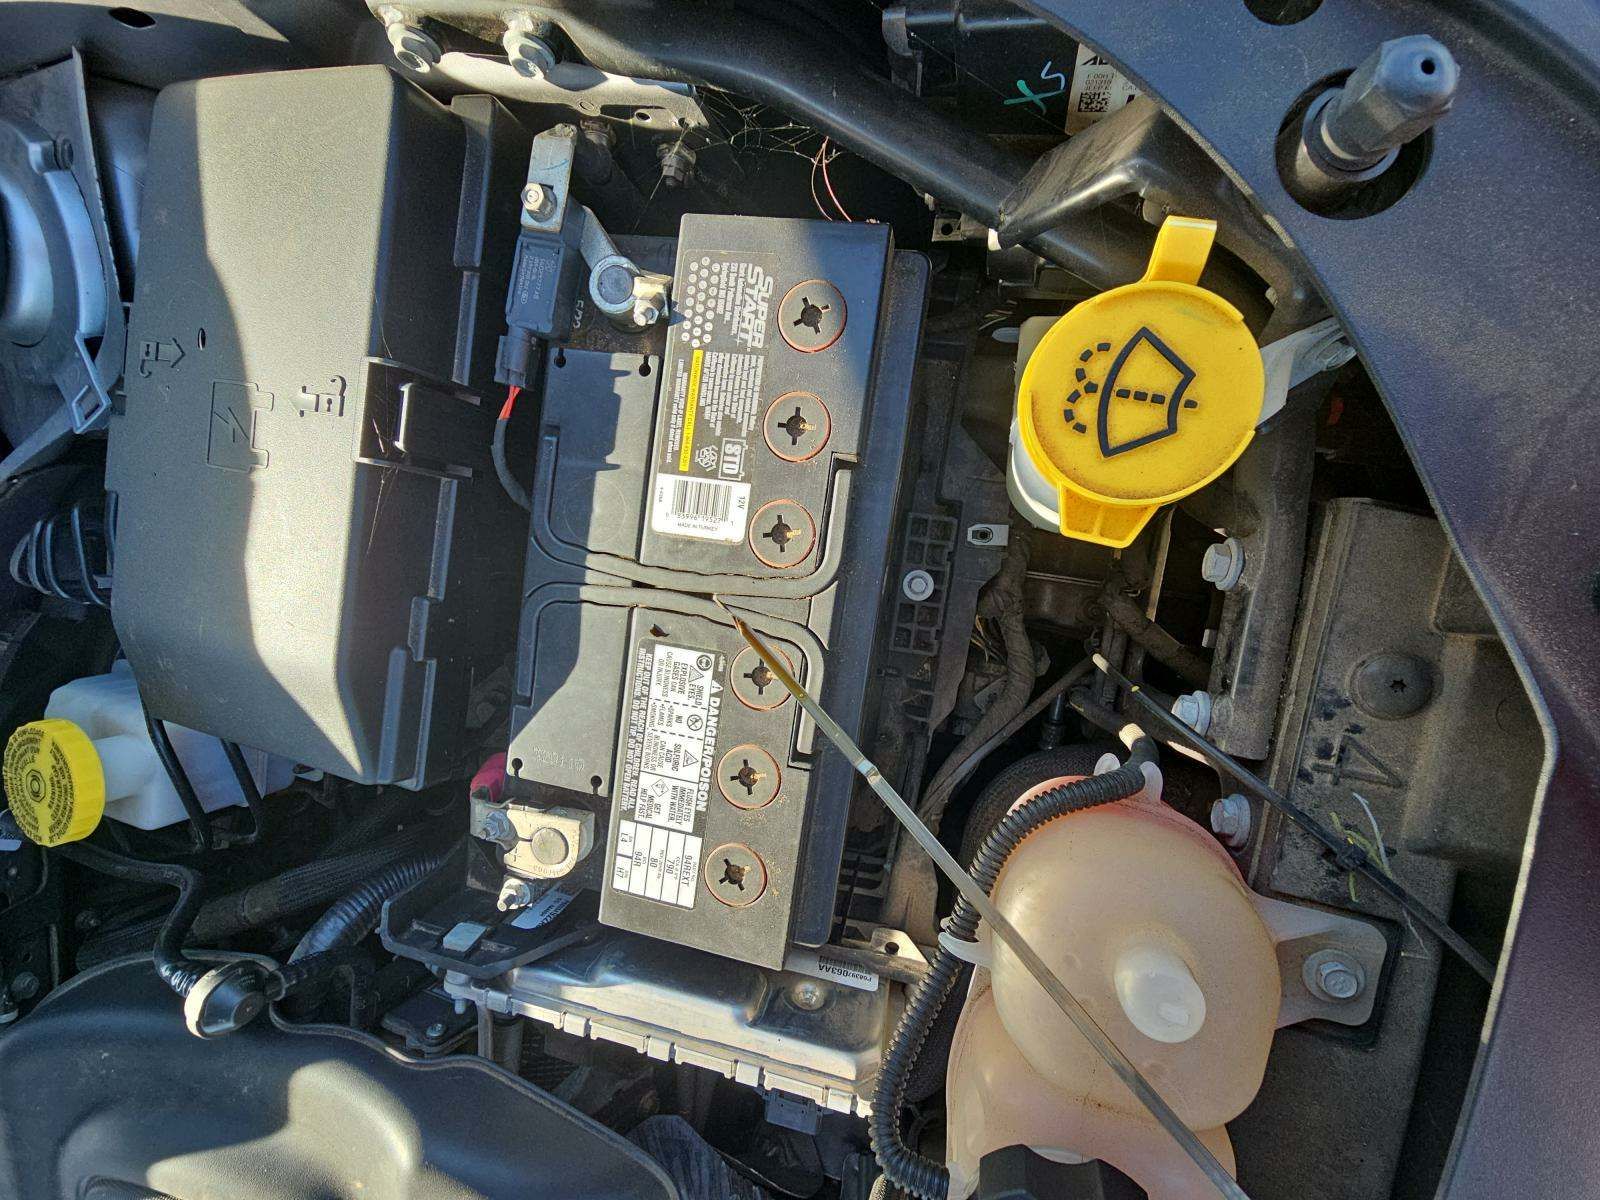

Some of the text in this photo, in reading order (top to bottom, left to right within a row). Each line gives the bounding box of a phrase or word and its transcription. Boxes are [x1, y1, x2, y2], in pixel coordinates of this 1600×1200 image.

[737, 263, 765, 347] START
[751, 275, 774, 348] SUPER
[722, 443, 741, 475] STD
[736, 496, 745, 509] 12V
[644, 653, 652, 670] KEEP
[642, 671, 650, 685] OUT
[671, 661, 680, 680] GASES
[677, 662, 688, 694] EXPLOSIVE
[641, 685, 648, 696] OF
[694, 684, 704, 705] SHIELD
[632, 699, 639, 709] DO
[639, 696, 647, 709] THE
[636, 710, 646, 732] REACH
[674, 714, 682, 723] NO
[628, 738, 635, 749] DO
[635, 733, 643, 742] OF
[664, 748, 672, 762] ACID
[671, 743, 681, 771] SULFURIC
[695, 696, 720, 811] DANGER/POISON
[623, 763, 631, 781] OPEN
[629, 779, 637, 796] READ
[639, 788, 647, 802] HELP
[670, 785, 678, 801] WITH
[627, 797, 635, 809] ALL
[653, 803, 661, 814] GET
[675, 786, 685, 824] IMMEDIATELY
[683, 788, 693, 821] FLUSH EYES
[620, 832, 628, 842] L4
[633, 851, 642, 866] 94R
[649, 857, 658, 867] 80
[665, 858, 674, 874] 790
[615, 866, 624, 878] H7
[681, 854, 692, 886] 94REXT
